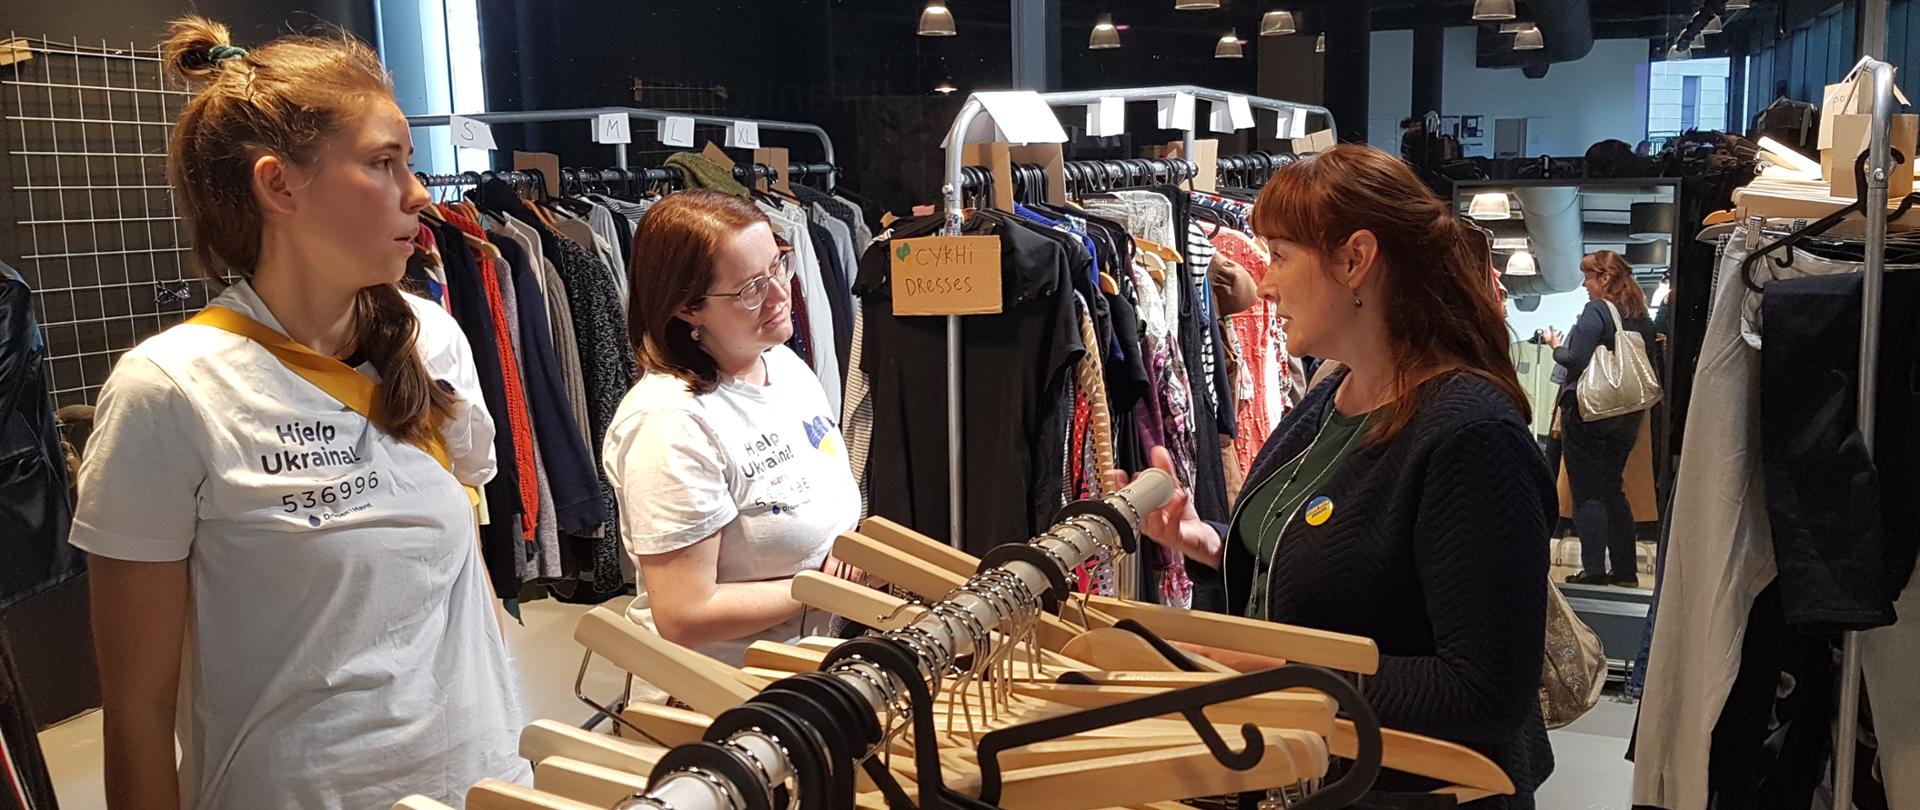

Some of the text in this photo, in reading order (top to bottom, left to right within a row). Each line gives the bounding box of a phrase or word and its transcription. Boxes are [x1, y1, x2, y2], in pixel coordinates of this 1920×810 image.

[460, 121, 474, 141] S
[606, 119, 620, 139] M
[670, 123, 682, 143] L
[737, 128, 757, 146] XL
[276, 421, 335, 446] Hjelp
[282, 471, 379, 513] 536996
